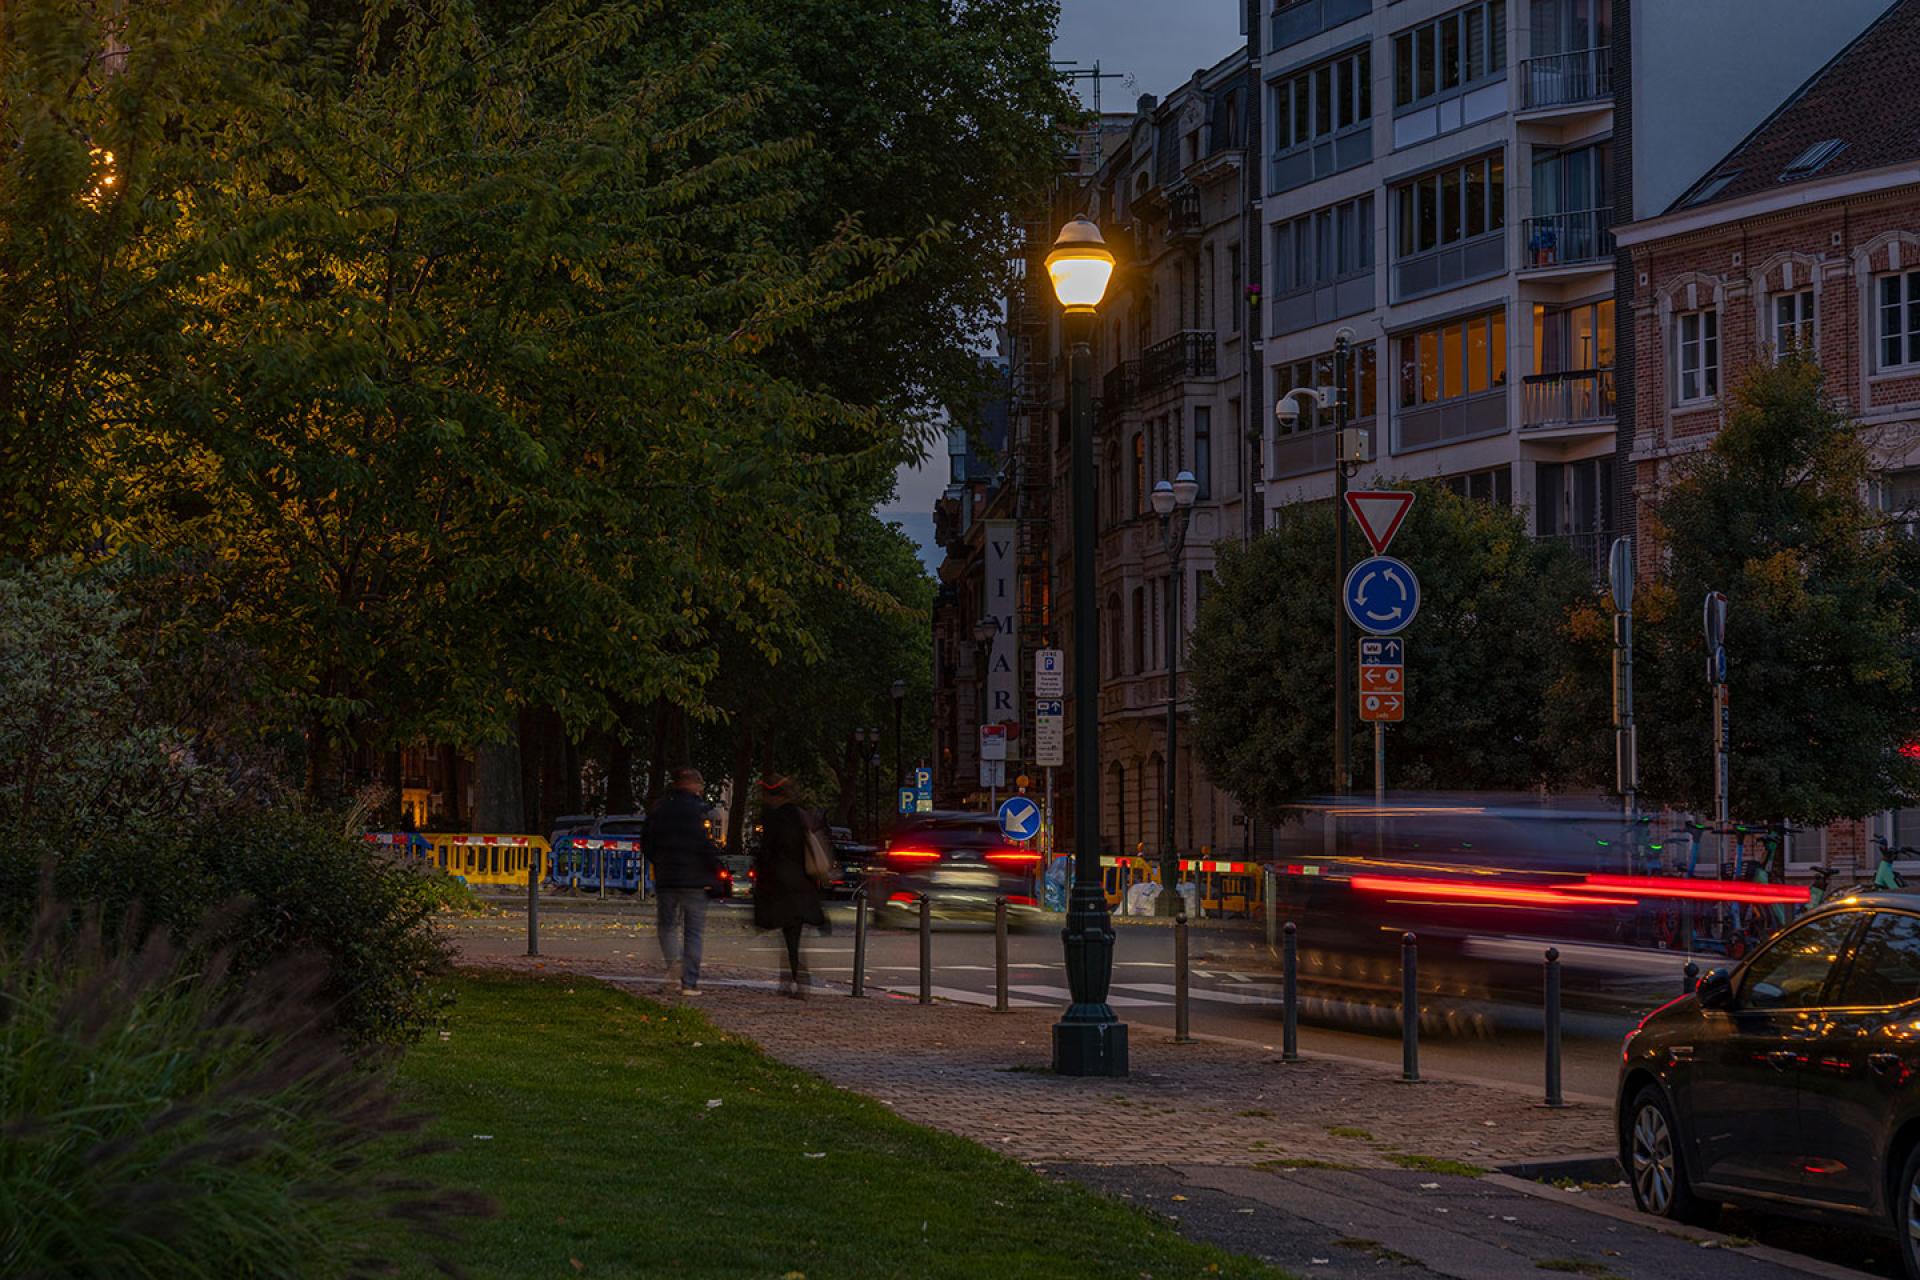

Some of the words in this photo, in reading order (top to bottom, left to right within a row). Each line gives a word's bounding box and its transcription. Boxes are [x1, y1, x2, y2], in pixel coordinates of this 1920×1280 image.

[992, 541, 1013, 711] VIMAR
[918, 772, 929, 788] P
[902, 792, 914, 809] P
